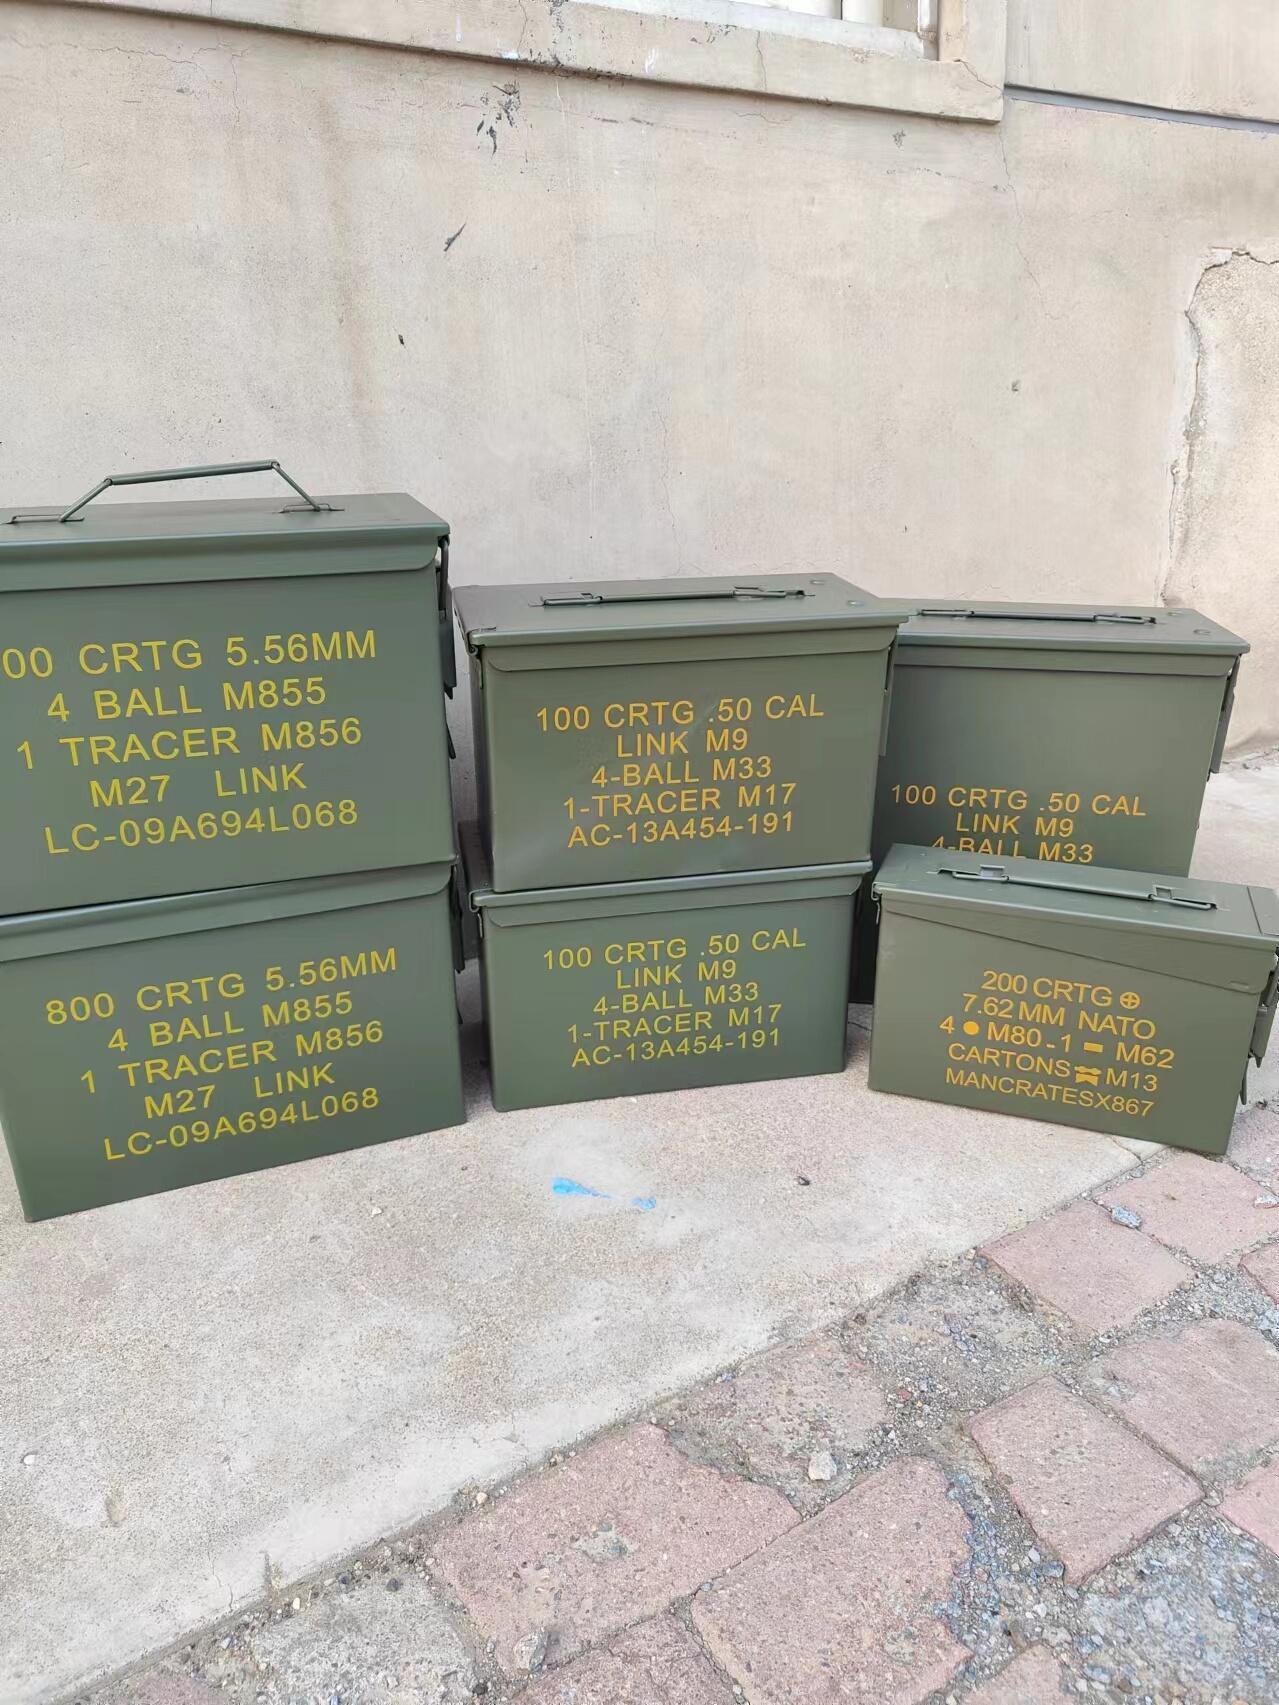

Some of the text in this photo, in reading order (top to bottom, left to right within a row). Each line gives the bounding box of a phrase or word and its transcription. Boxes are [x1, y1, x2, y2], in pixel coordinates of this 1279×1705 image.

[79, 639, 202, 675] CRTG
[226, 630, 376, 666] 5.56MM
[48, 677, 325, 722] 4 BALL M855
[537, 694, 824, 732] 100 CRTG .50 CAL
[17, 718, 361, 769] 1 TRACER M856
[616, 729, 748, 758] LINK M9
[90, 764, 307, 807] M27 LINK
[591, 756, 772, 787] 4-BALL M33
[564, 783, 796, 820] 1-TRACER M17
[891, 785, 1146, 817] 100 CRTG .50 CAL
[45, 800, 357, 854] LC-09A694L068
[568, 812, 793, 847] AC-13A454-191
[956, 812, 1074, 837] LINK M9
[1038, 841, 1094, 862] M33
[543, 928, 805, 970] 100 CRTG .50 CAL
[47, 948, 396, 1024] 800 CRTG 5.56MM
[616, 959, 737, 989] LINK M9
[593, 983, 758, 1015] 4-BALL M33
[108, 991, 352, 1051] 4 BALL M855
[568, 1004, 781, 1043] 1-TRACER M17
[1079, 1010, 1156, 1039] NATO
[81, 1021, 382, 1094] 1 TRACER M856
[572, 1029, 779, 1067] AC-13A454-191
[939, 1017, 954, 1034] 4
[1116, 1042, 1175, 1068] M62
[948, 1043, 1158, 1093] CARTONS M13
[145, 1063, 334, 1118] M27 LINK
[946, 1068, 1154, 1117] MANCRATESX867
[104, 1087, 378, 1160] LC-09A694L068
